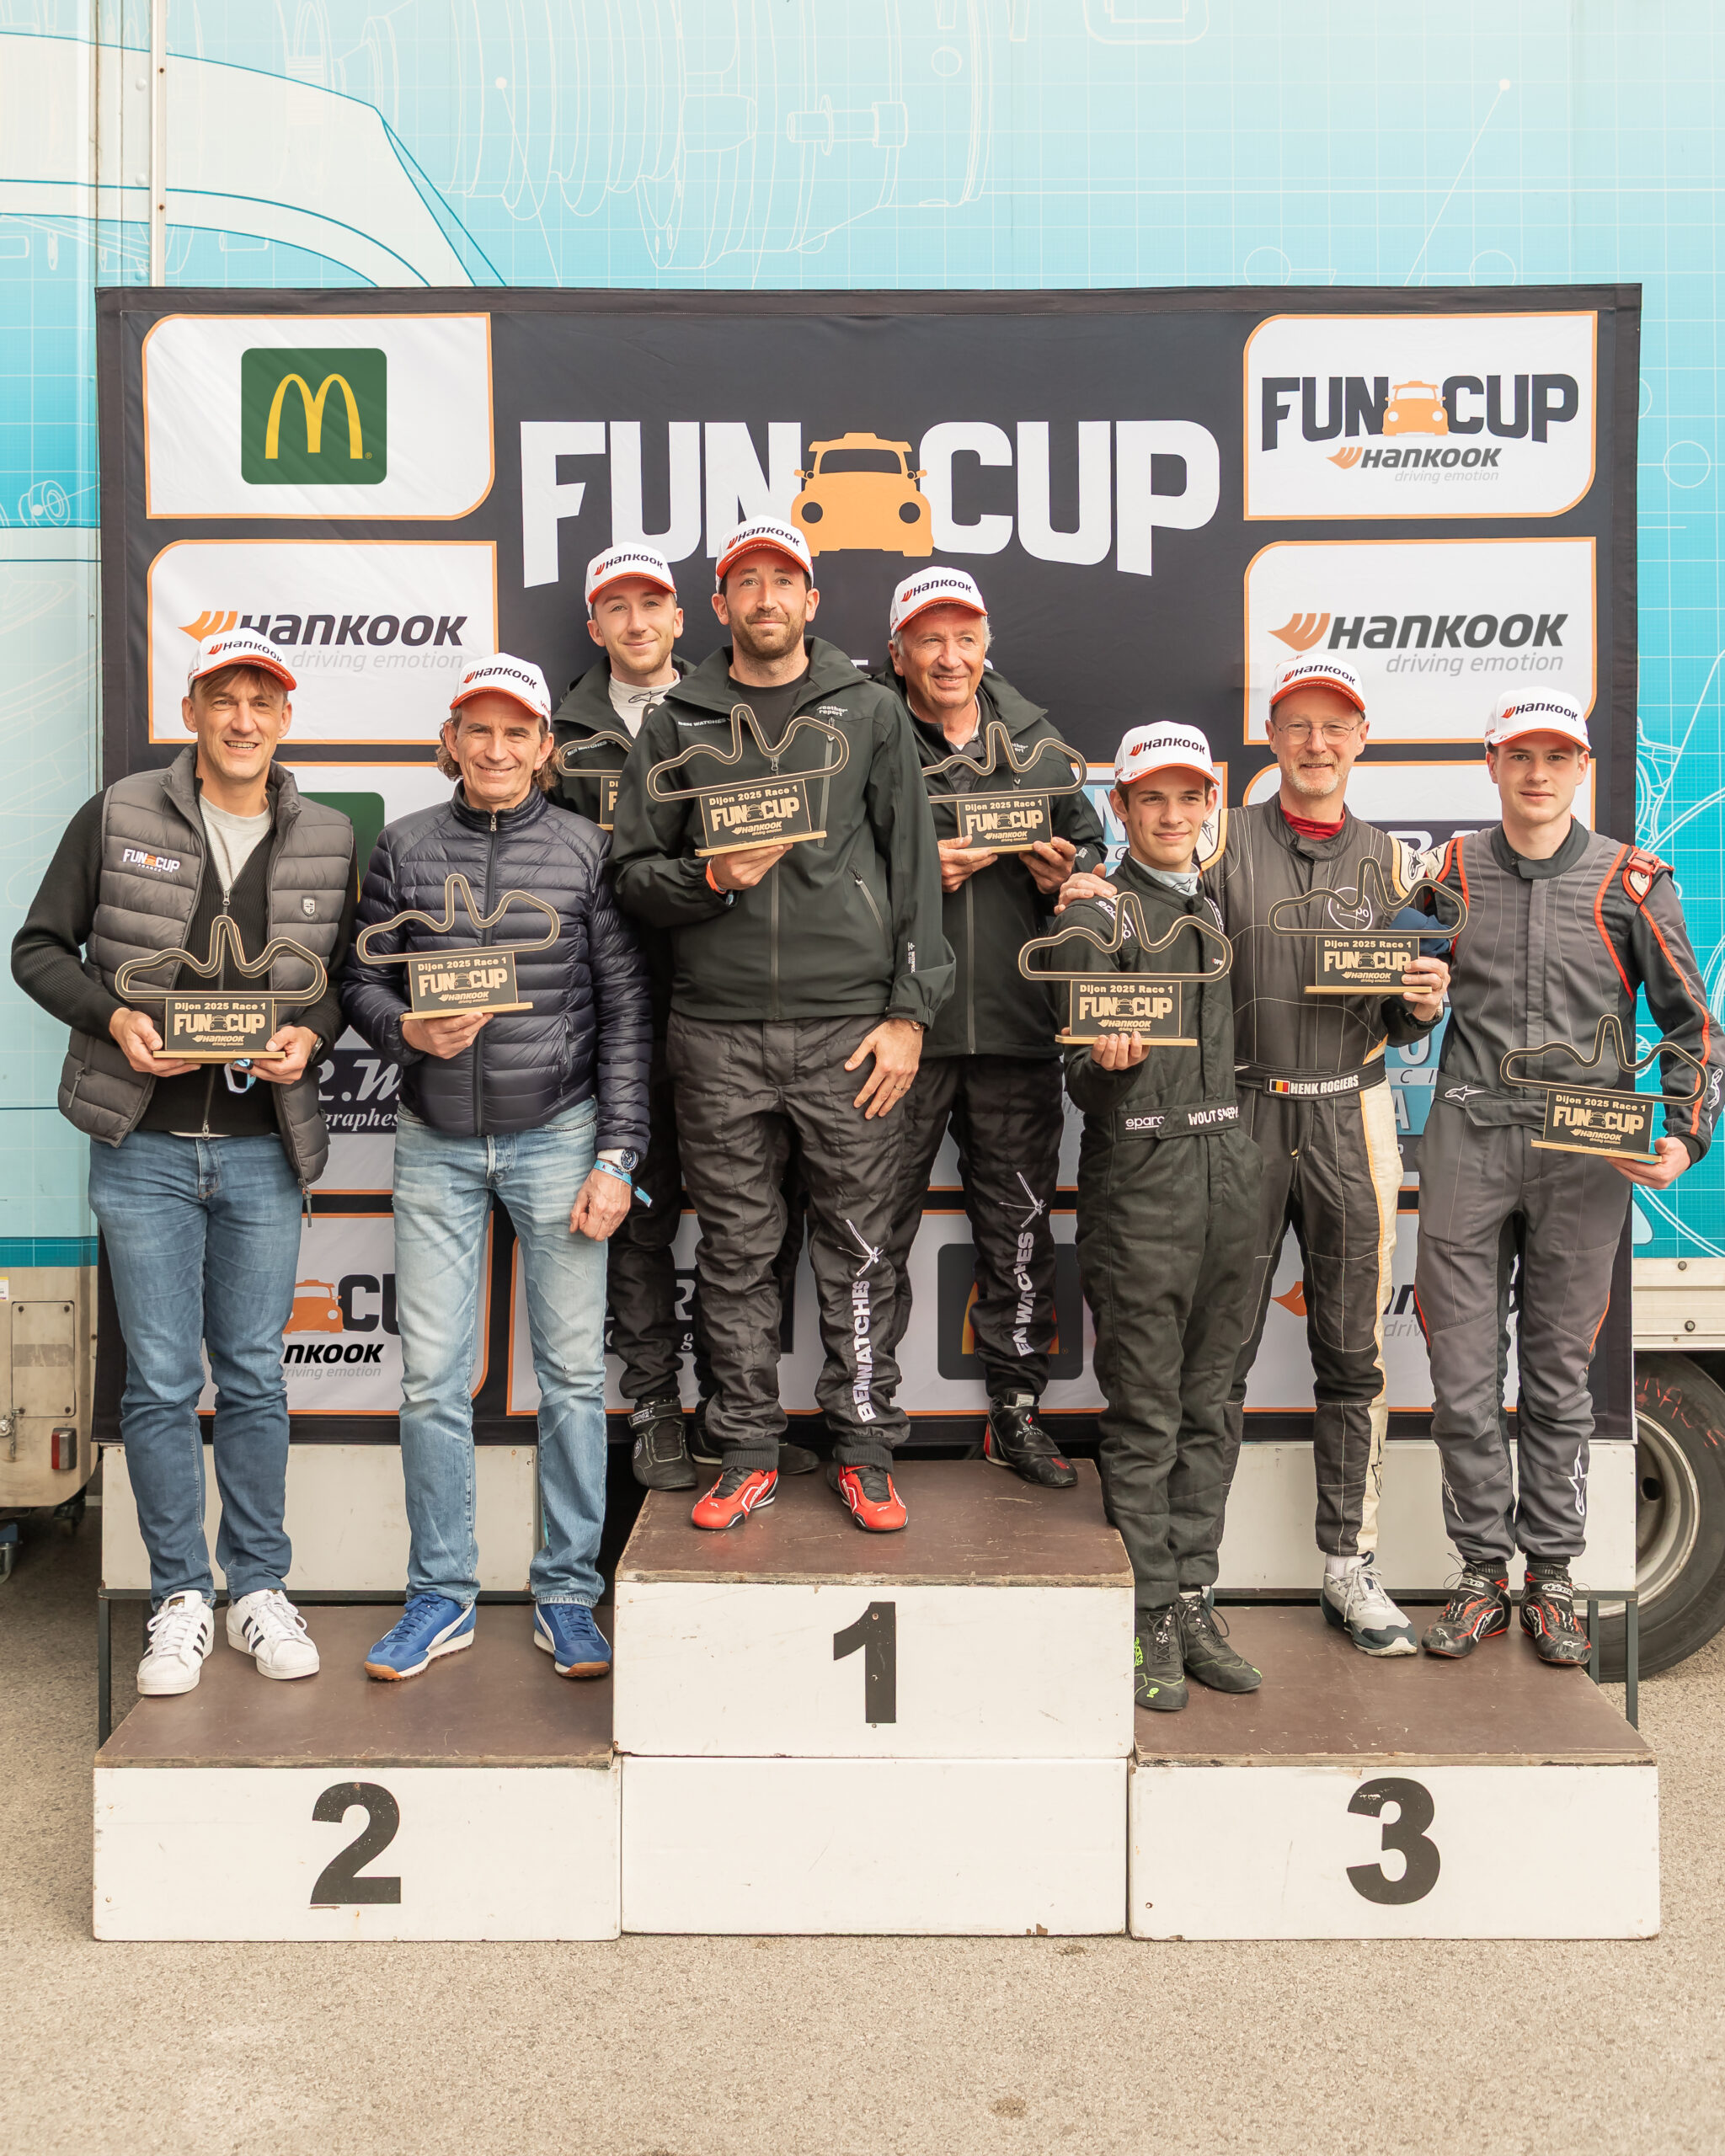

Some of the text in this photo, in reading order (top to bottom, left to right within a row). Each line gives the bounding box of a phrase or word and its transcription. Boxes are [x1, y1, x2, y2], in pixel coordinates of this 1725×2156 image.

[1262, 374, 1578, 451] FUN CUP
[1394, 470, 1498, 484] driving emotion
[521, 420, 1220, 588] FUN CUP
[291, 650, 463, 672] driving emotion
[1386, 654, 1563, 676] driving emotion
[709, 796, 734, 806] Dijon
[738, 791, 762, 801] 2025
[765, 787, 790, 797] Race
[710, 797, 800, 831] FUN CUP
[964, 803, 987, 812] Dijon
[965, 809, 1044, 836] FUN CUP
[122, 848, 181, 873] FUN CUP
[1324, 940, 1349, 948] Dijon
[418, 963, 443, 972] Dijon
[446, 960, 471, 969] 2025
[473, 958, 499, 966] Race
[1324, 951, 1412, 972] FUN CUP
[418, 969, 508, 997] FUN CUP
[1080, 985, 1107, 994] Dijon
[1110, 985, 1135, 993] 2025
[174, 1002, 200, 1011] Dijon
[1079, 996, 1173, 1020] FUN CUP
[174, 1013, 265, 1036] FUN CUP
[1290, 1075, 1359, 1095] HENK ROGIERS
[1556, 1094, 1646, 1113] Dijon 2025 Race 1
[1125, 1115, 1164, 1130] sparc
[1188, 1113, 1217, 1126] WOUT
[1552, 1105, 1644, 1134] FUN CUP
[283, 1344, 384, 1364] NKOOK
[285, 1366, 382, 1380] riving emotion
[833, 1601, 896, 1724] 1
[310, 1781, 402, 1905] 2
[1346, 1777, 1441, 1905] 3
